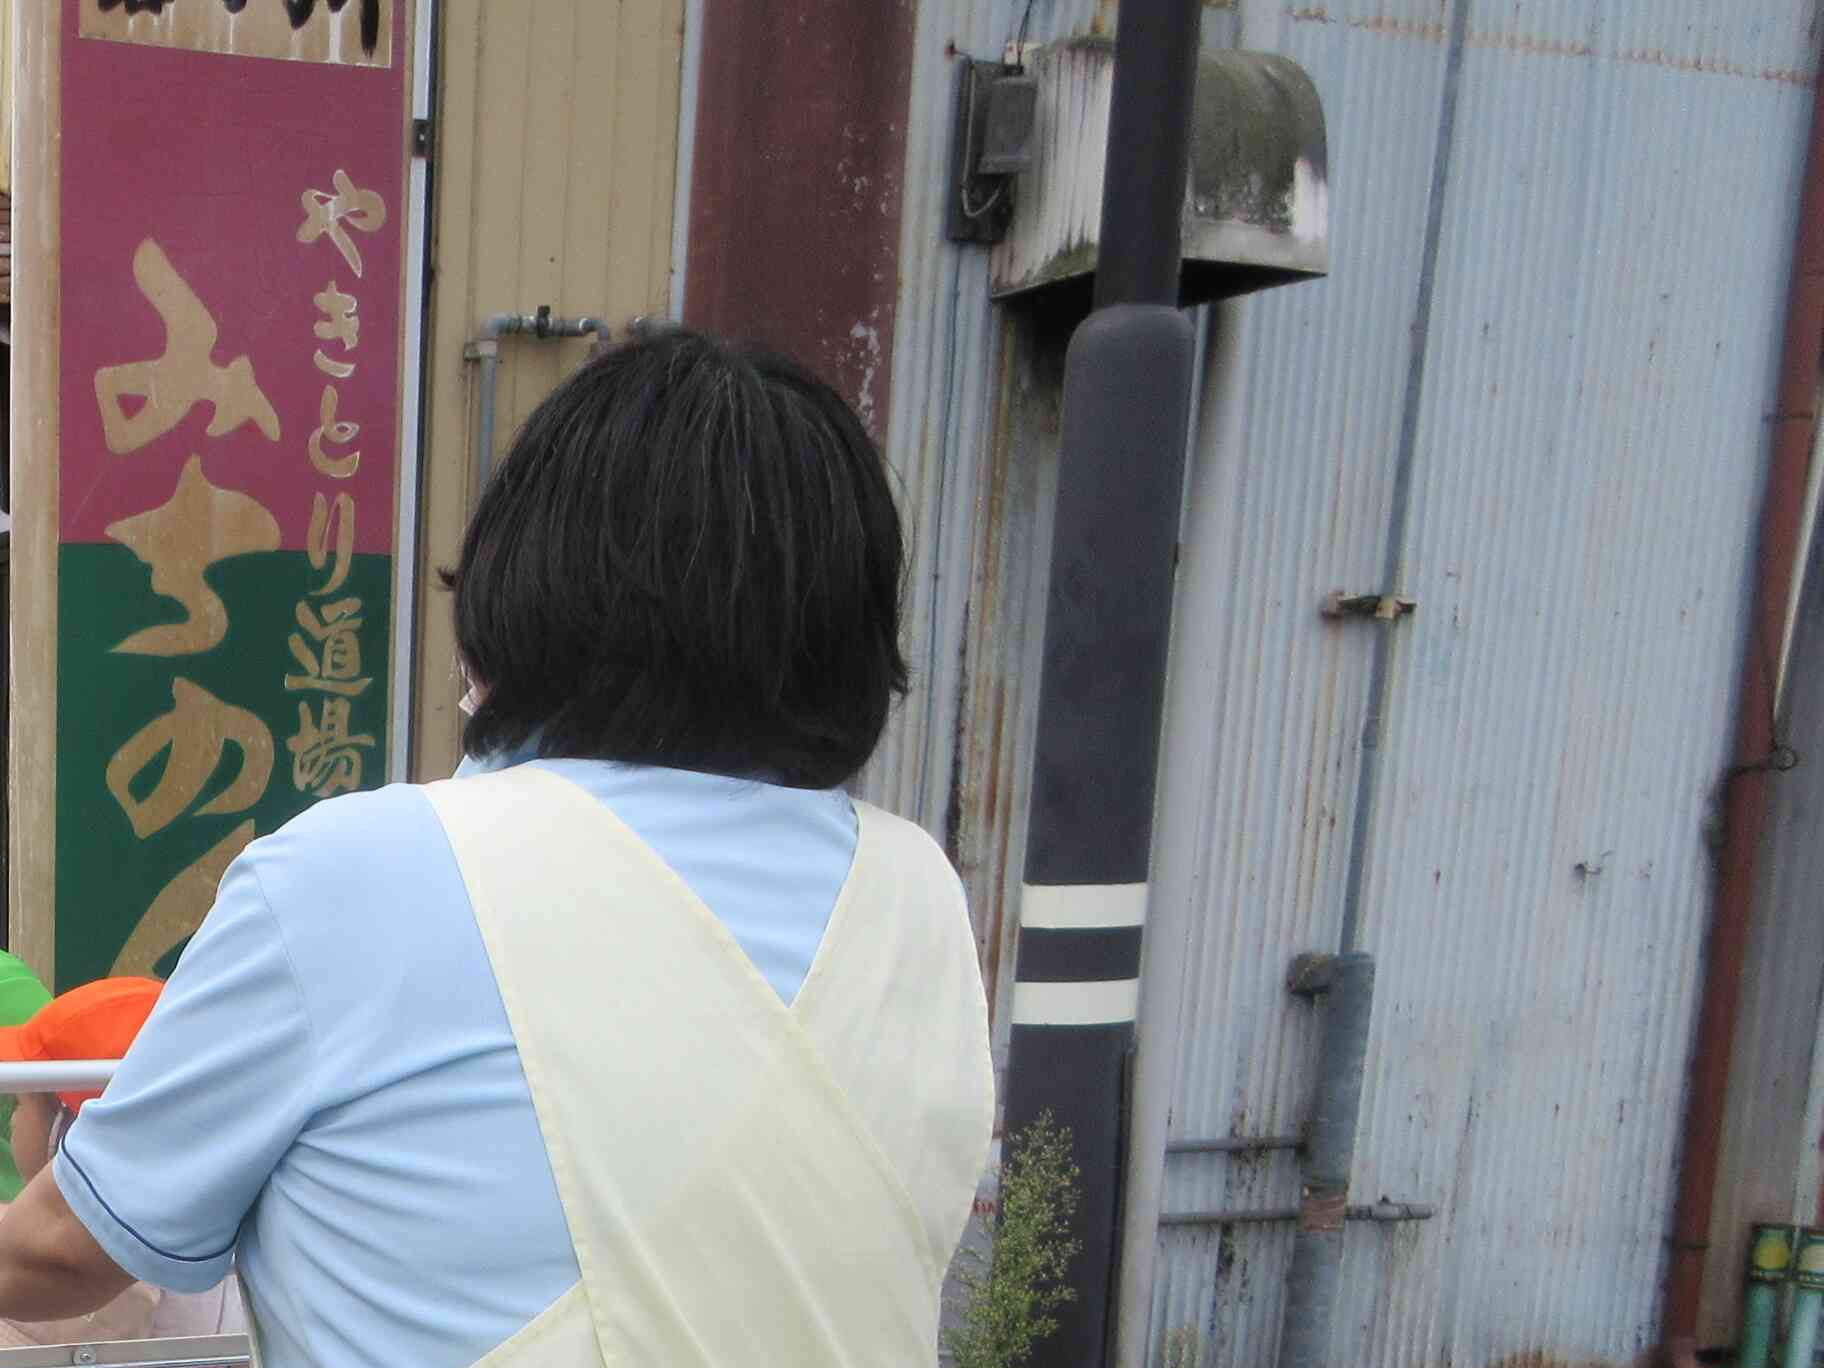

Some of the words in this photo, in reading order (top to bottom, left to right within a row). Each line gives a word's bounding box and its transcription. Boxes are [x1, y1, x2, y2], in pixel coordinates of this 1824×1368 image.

[283, 168, 388, 798] やきとり道場
